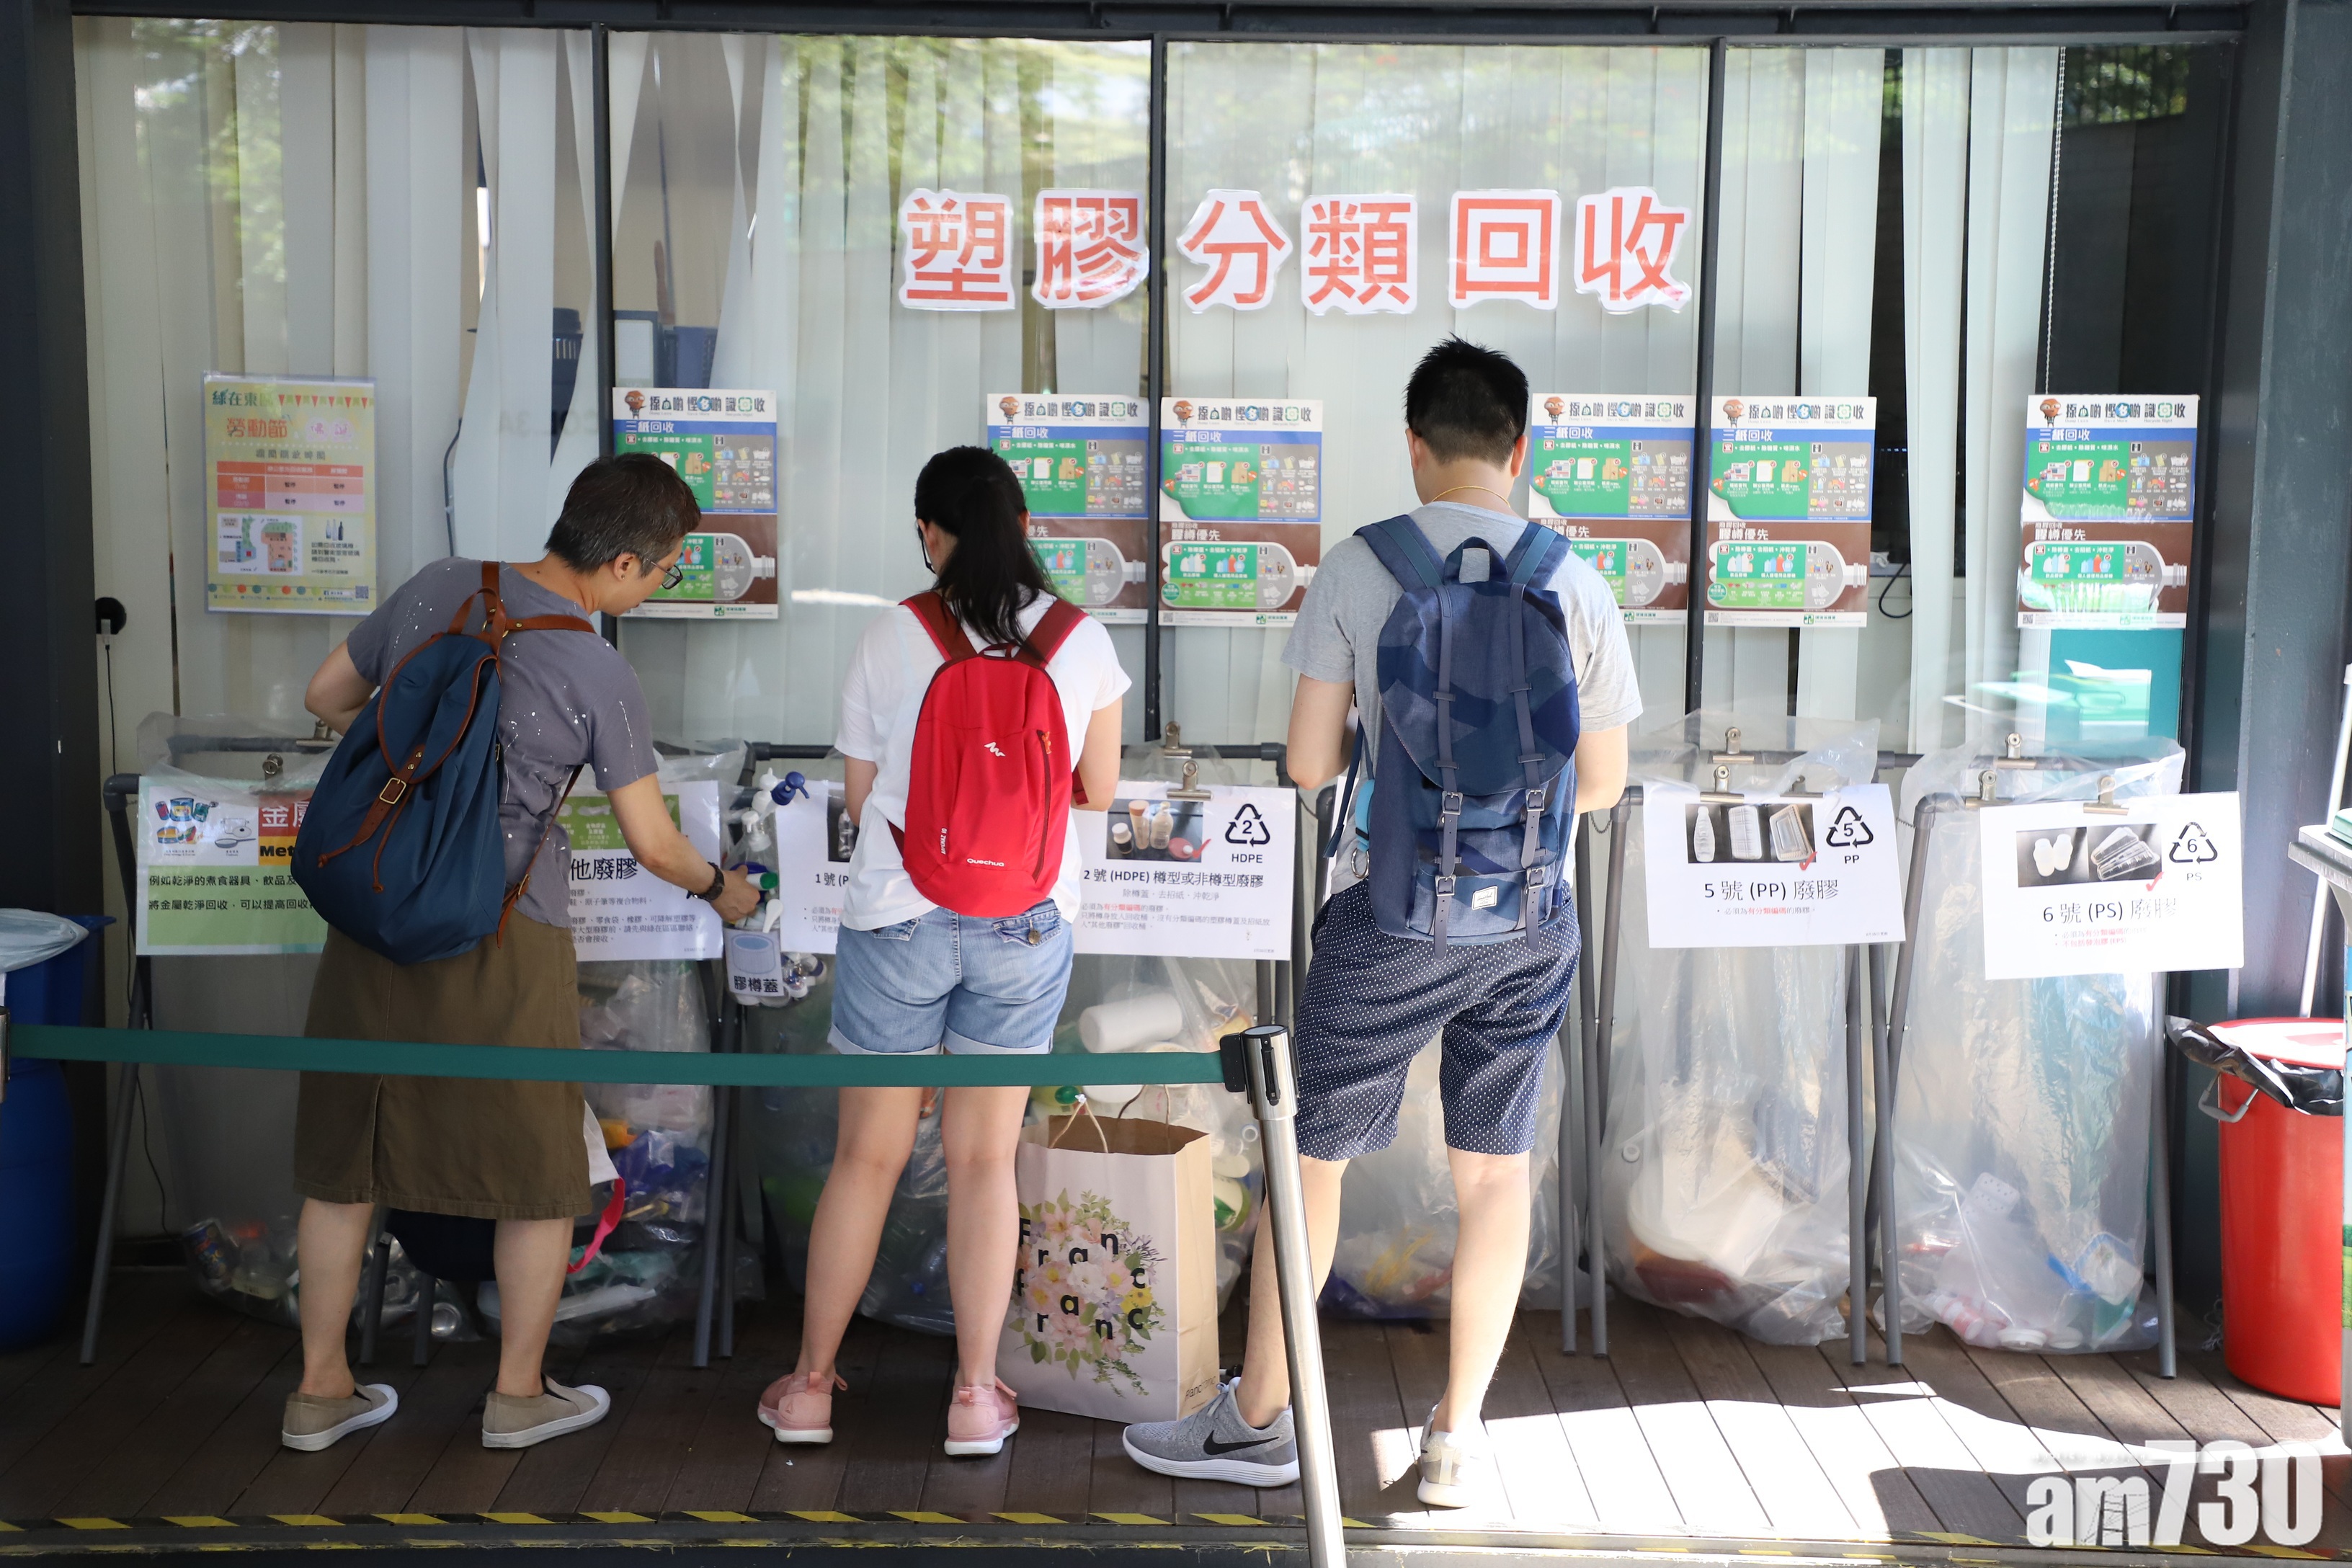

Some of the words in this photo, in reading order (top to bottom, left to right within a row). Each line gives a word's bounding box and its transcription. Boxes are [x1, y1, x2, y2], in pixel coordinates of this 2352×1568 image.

[906, 197, 1686, 304] 塑膠分類回收
[226, 417, 288, 438] 勞動節
[625, 421, 674, 433] 三紙回收
[999, 427, 1048, 438] 三紙回收
[1544, 427, 1593, 439] 三紙回收
[1173, 431, 1221, 442] 三紙回收
[1722, 429, 1773, 442] 三紙回收
[2039, 429, 2090, 441] 三紙回收
[1242, 820, 1252, 834] 2
[1843, 823, 1854, 837] 5
[2188, 839, 2197, 852] 6
[966, 858, 1005, 867] Quechua
[1231, 854, 1263, 863] HDPE
[1844, 855, 1859, 864] PP
[571, 858, 638, 881] 他廢膠
[816, 874, 821, 883] 1
[824, 873, 835, 886] 號
[1084, 870, 1090, 880] 2
[1093, 869, 1107, 882] 號
[1110, 870, 1150, 883] (HDPE)
[1153, 870, 1264, 888] 樽型或非樽型廢膠
[2186, 873, 2202, 881] PS
[1704, 883, 1714, 898] 5
[1721, 881, 1743, 900] 號
[1750, 882, 1786, 901] (PP)
[1794, 879, 1838, 900] 廢膠
[2043, 906, 2054, 922] 6
[2060, 902, 2081, 924] 號
[2088, 901, 2123, 922] (PS)
[734, 976, 778, 993] 膠樽蓋
